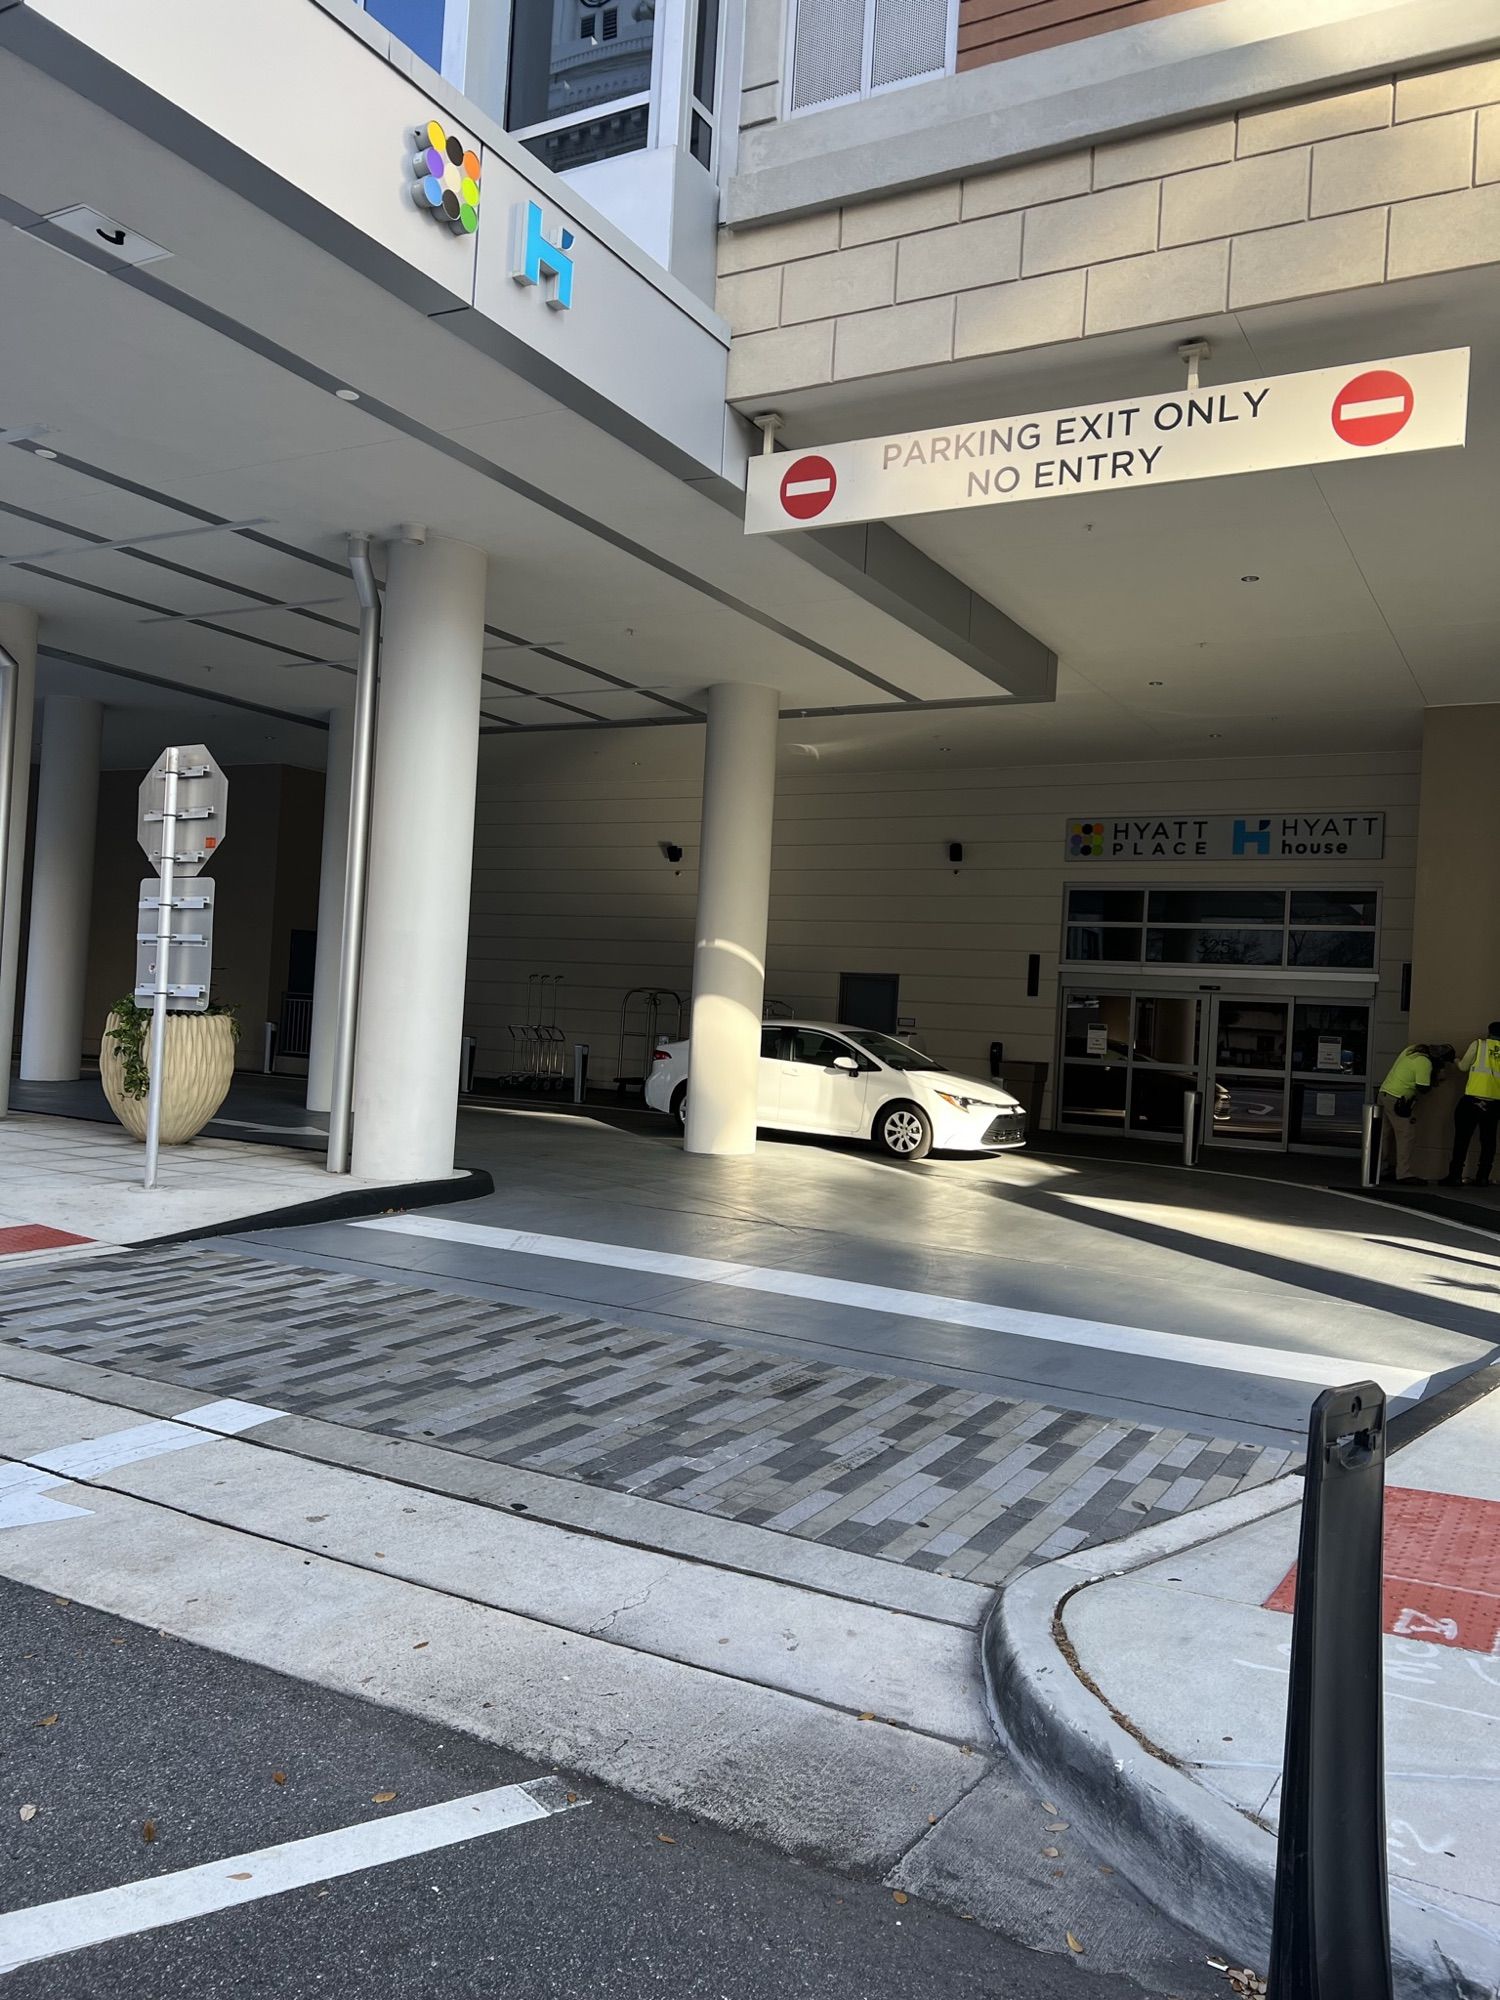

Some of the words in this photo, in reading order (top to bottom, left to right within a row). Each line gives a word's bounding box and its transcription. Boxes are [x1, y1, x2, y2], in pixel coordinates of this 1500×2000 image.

[882, 423, 1041, 470] PARKING
[1056, 407, 1140, 446] EXIT
[1154, 388, 1270, 431] ONLY
[967, 466, 1020, 498] NO
[1035, 445, 1163, 489] ENTRY
[1113, 821, 1209, 840] HYATT
[1281, 817, 1379, 836] HYATT
[1113, 841, 1207, 856] PLACE
[1281, 839, 1348, 855] house
